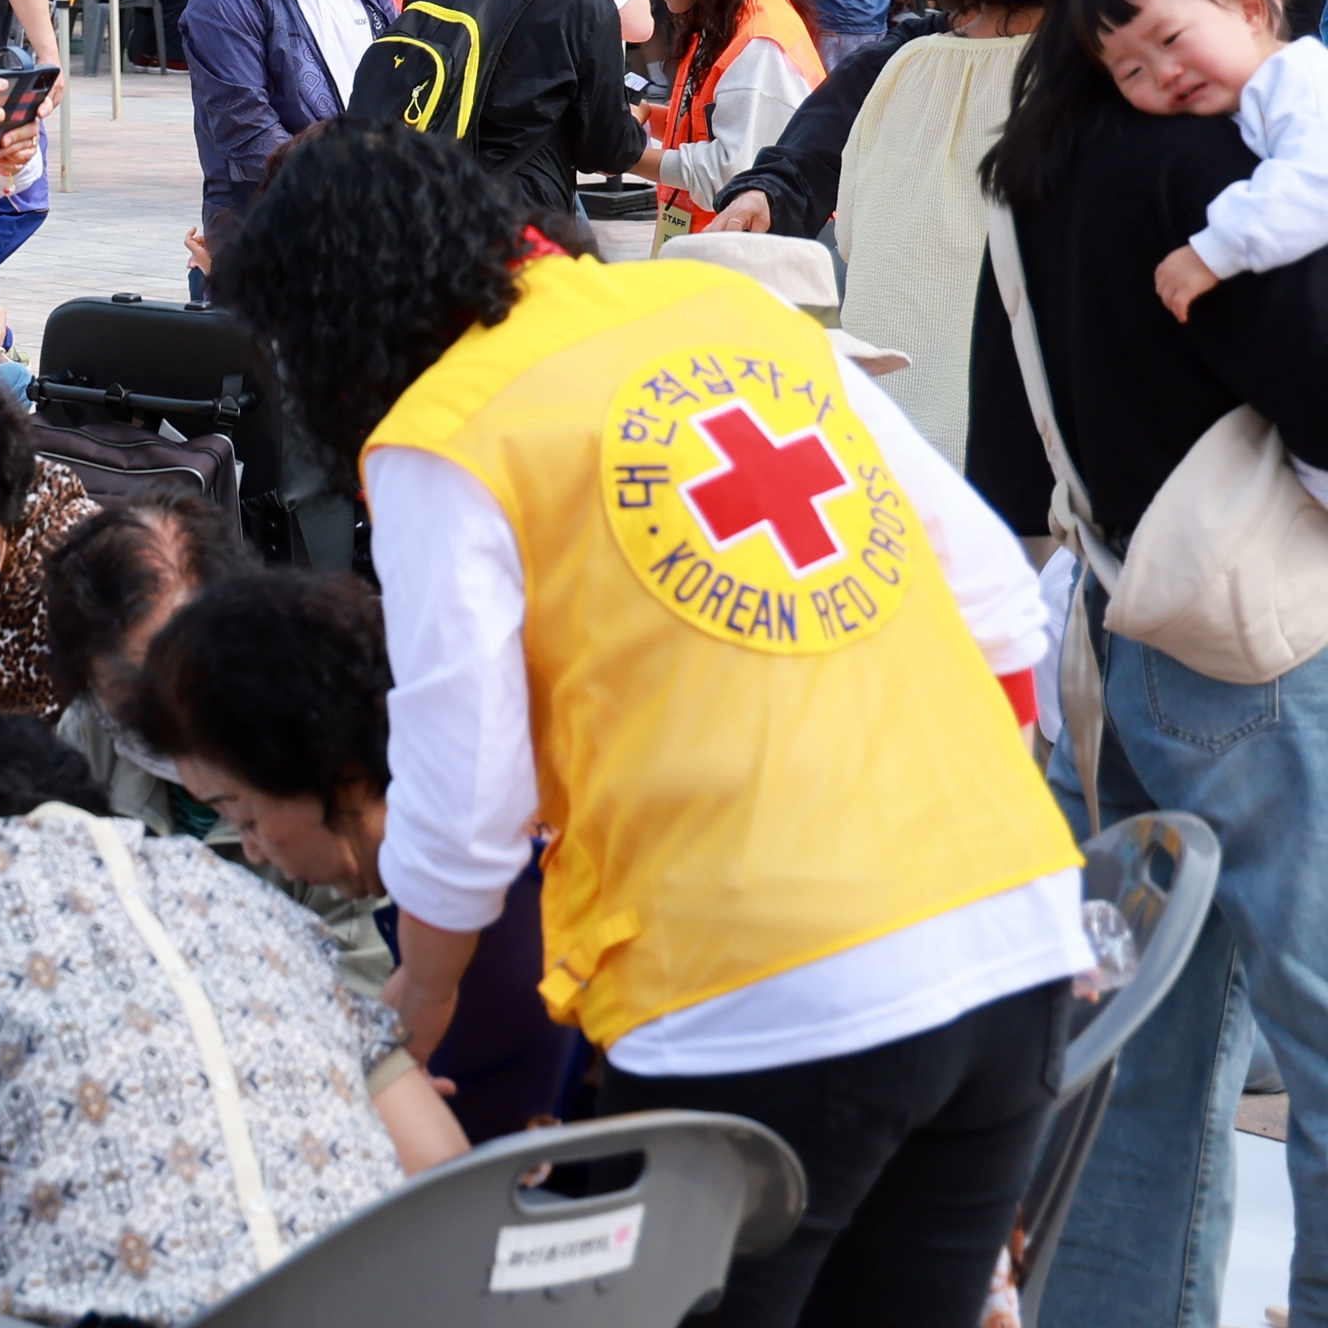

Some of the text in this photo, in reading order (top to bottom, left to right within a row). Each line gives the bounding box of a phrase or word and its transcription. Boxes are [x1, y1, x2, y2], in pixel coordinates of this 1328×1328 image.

[662, 212, 686, 228] STAFF
[614, 355, 835, 508] 대한적십자사
[649, 463, 907, 642] KOREAN RED CROSS
